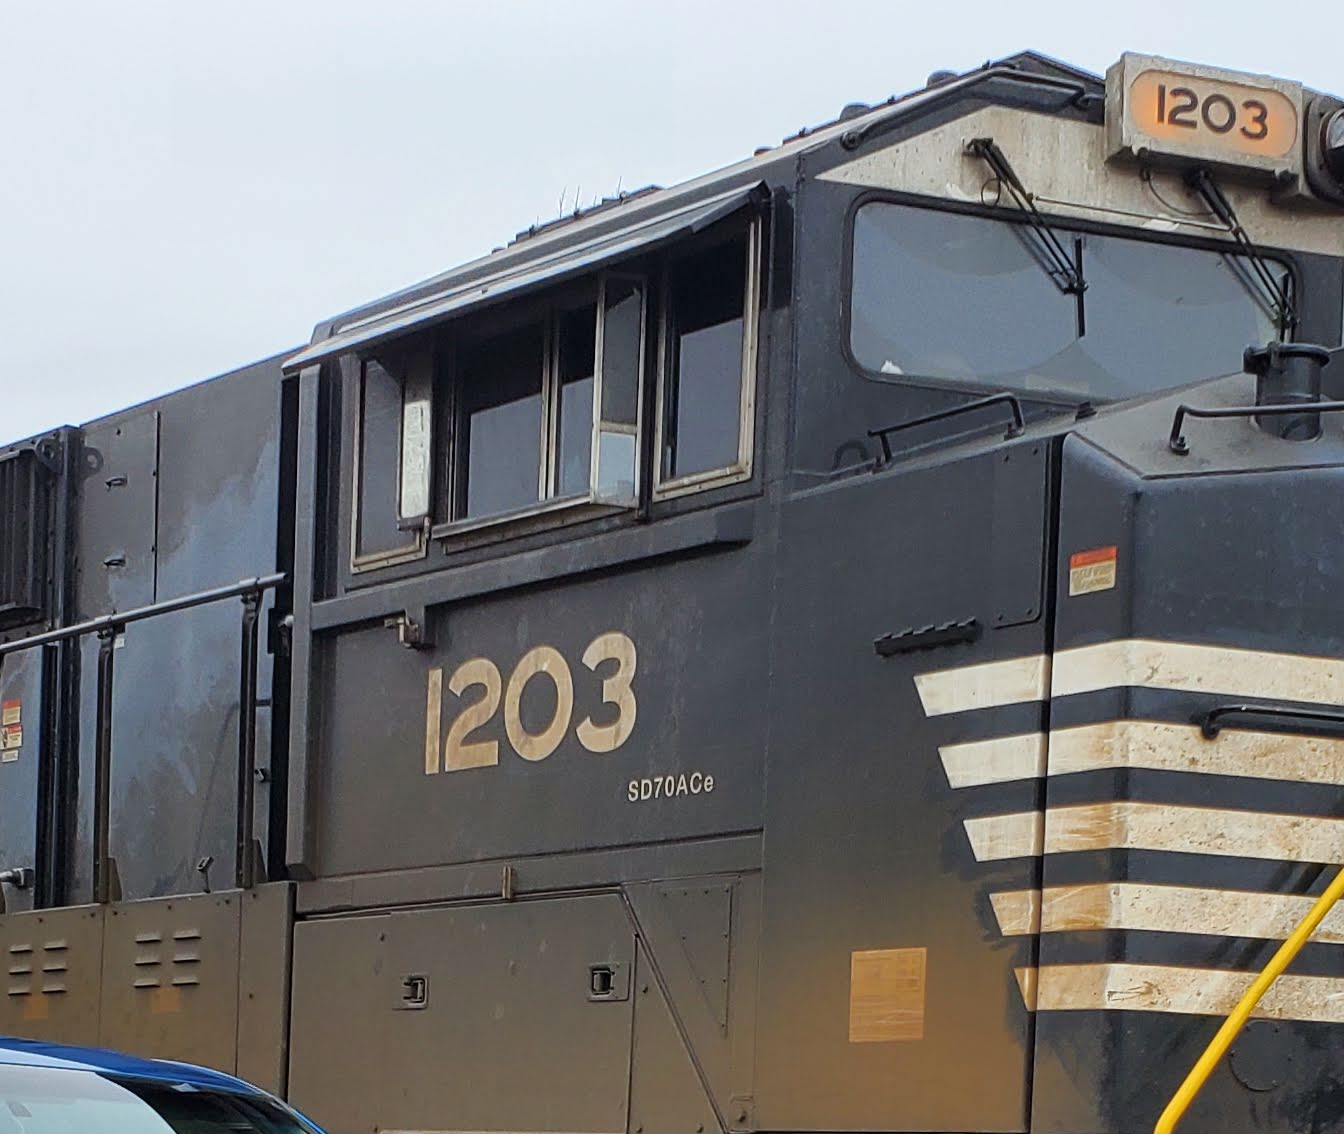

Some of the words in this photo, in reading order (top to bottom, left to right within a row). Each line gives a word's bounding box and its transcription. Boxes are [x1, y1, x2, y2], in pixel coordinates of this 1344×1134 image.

[1157, 84, 1268, 140] 1203
[425, 630, 638, 775] 1203
[627, 771, 714, 802] SD70ACe
